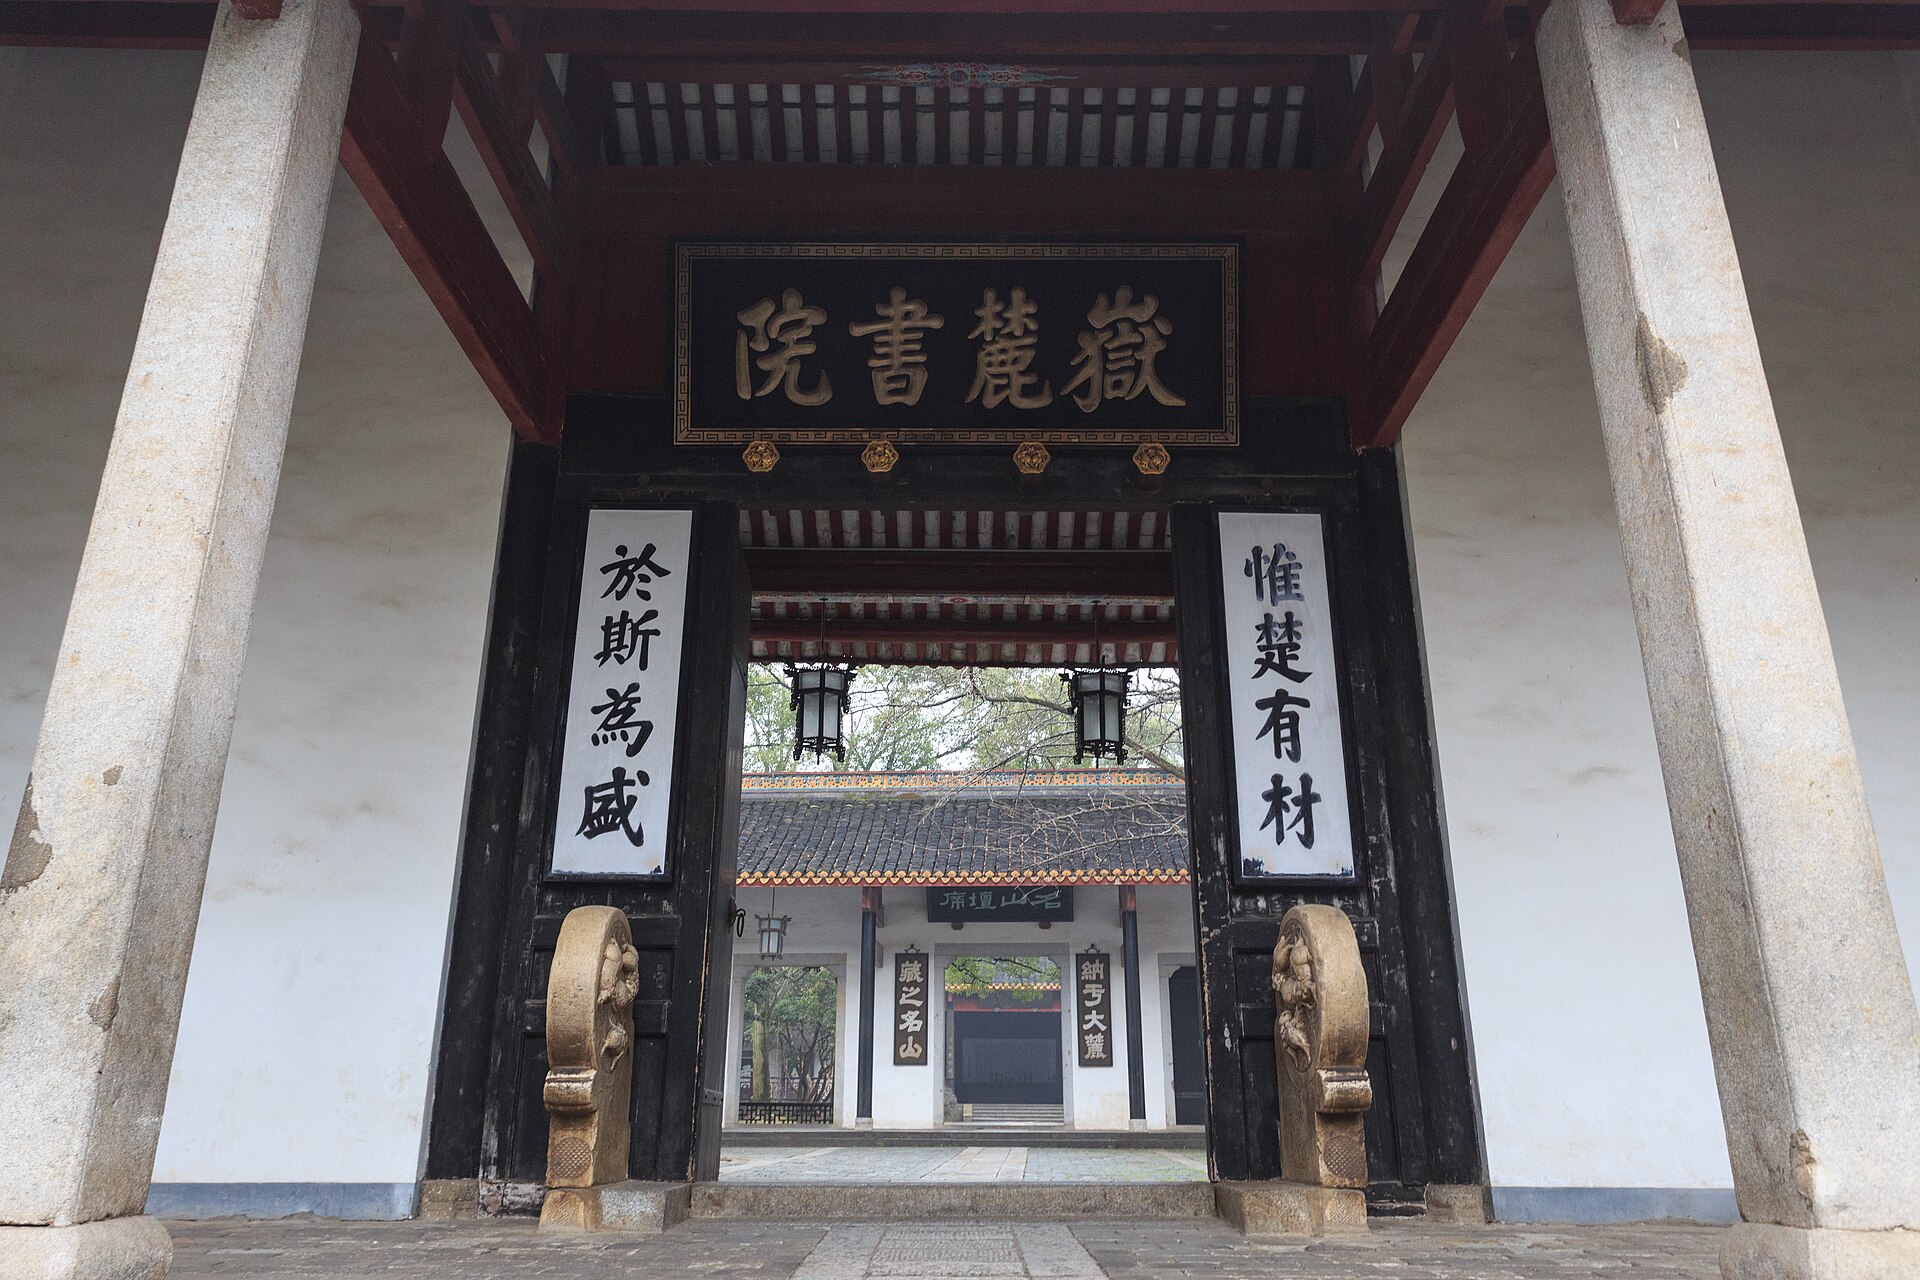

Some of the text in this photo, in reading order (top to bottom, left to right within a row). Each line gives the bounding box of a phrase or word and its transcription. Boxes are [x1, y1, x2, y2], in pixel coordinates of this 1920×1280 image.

[735, 285, 1187, 413] 嶽麓書院
[575, 542, 672, 847] 於斯為盛
[1243, 542, 1322, 850] 惟楚有材
[898, 960, 924, 1059] 藏之名山
